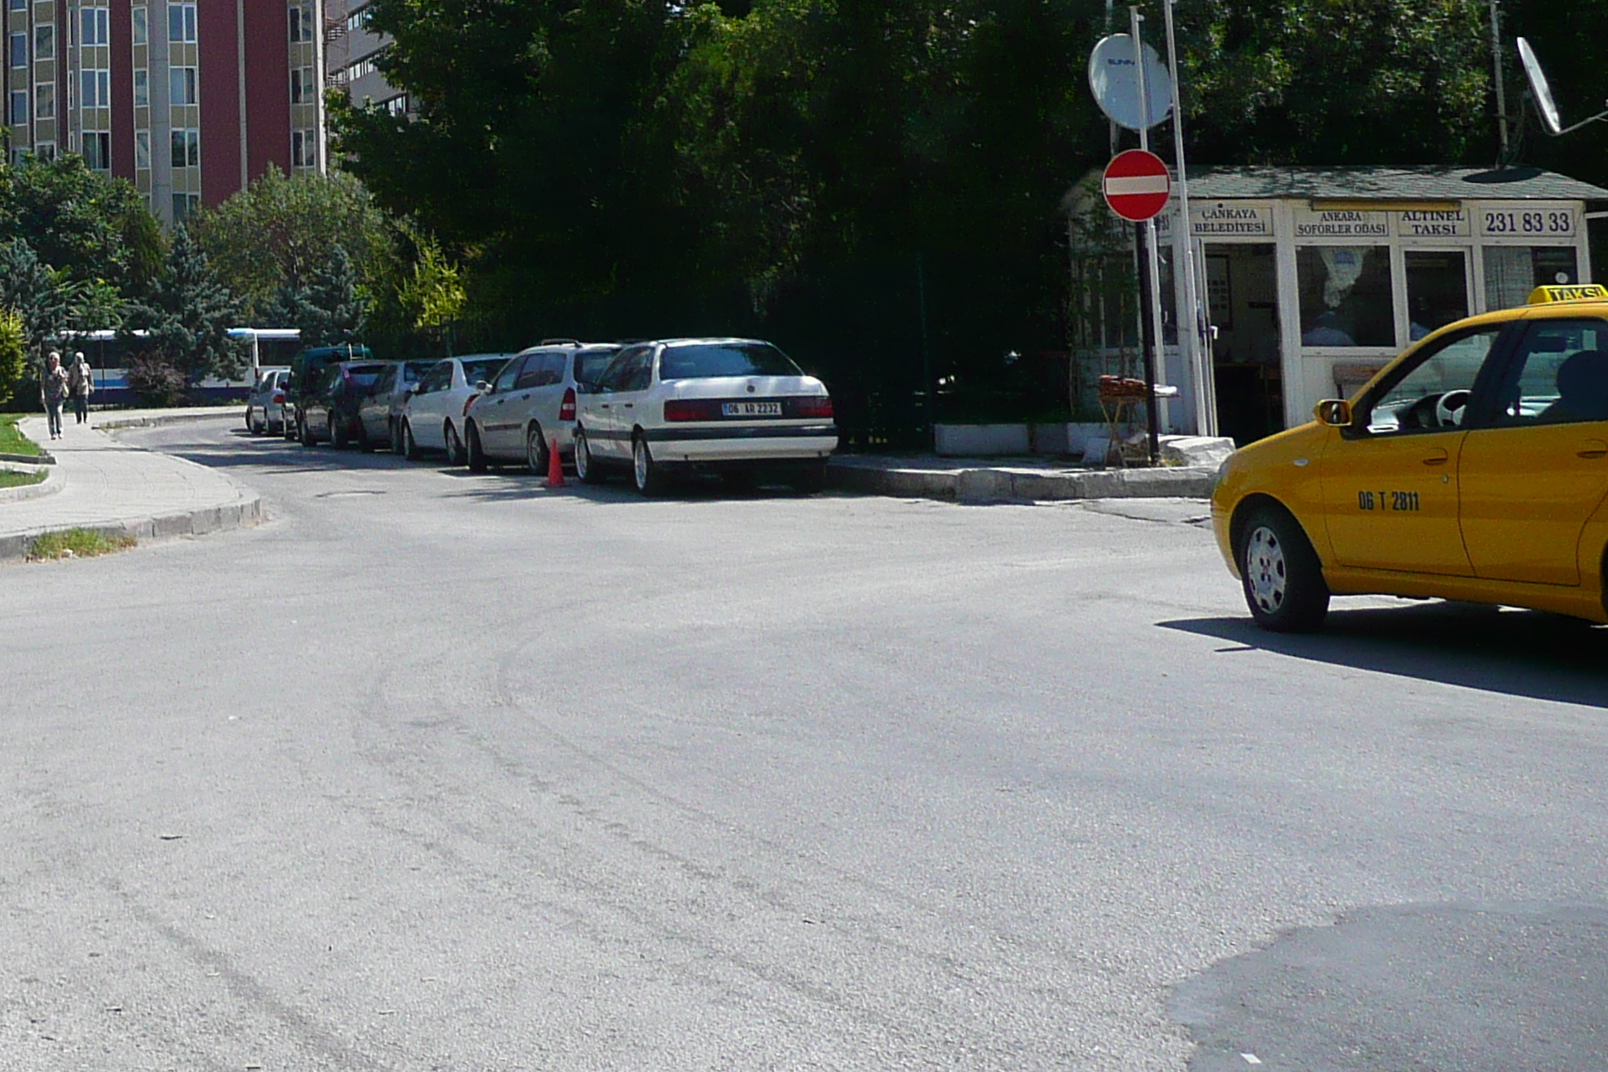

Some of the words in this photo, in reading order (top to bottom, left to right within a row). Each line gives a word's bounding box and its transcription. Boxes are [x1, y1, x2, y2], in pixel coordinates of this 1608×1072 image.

[1201, 209, 1257, 221] ÇANKAYA
[1320, 211, 1362, 221] ANKARA
[1402, 211, 1465, 221] ALTINEL
[1194, 220, 1266, 232] BELEDİYESİ
[1354, 223, 1386, 234] ODASI
[1411, 222, 1457, 234] TAKSİ
[1485, 213, 1517, 232] 231
[1522, 213, 1543, 232] 83
[1548, 213, 1570, 232] 33
[728, 403, 739, 414] 06
[1358, 491, 1374, 510] 06
[1378, 491, 1385, 510] T
[1391, 491, 1419, 511] 2811
